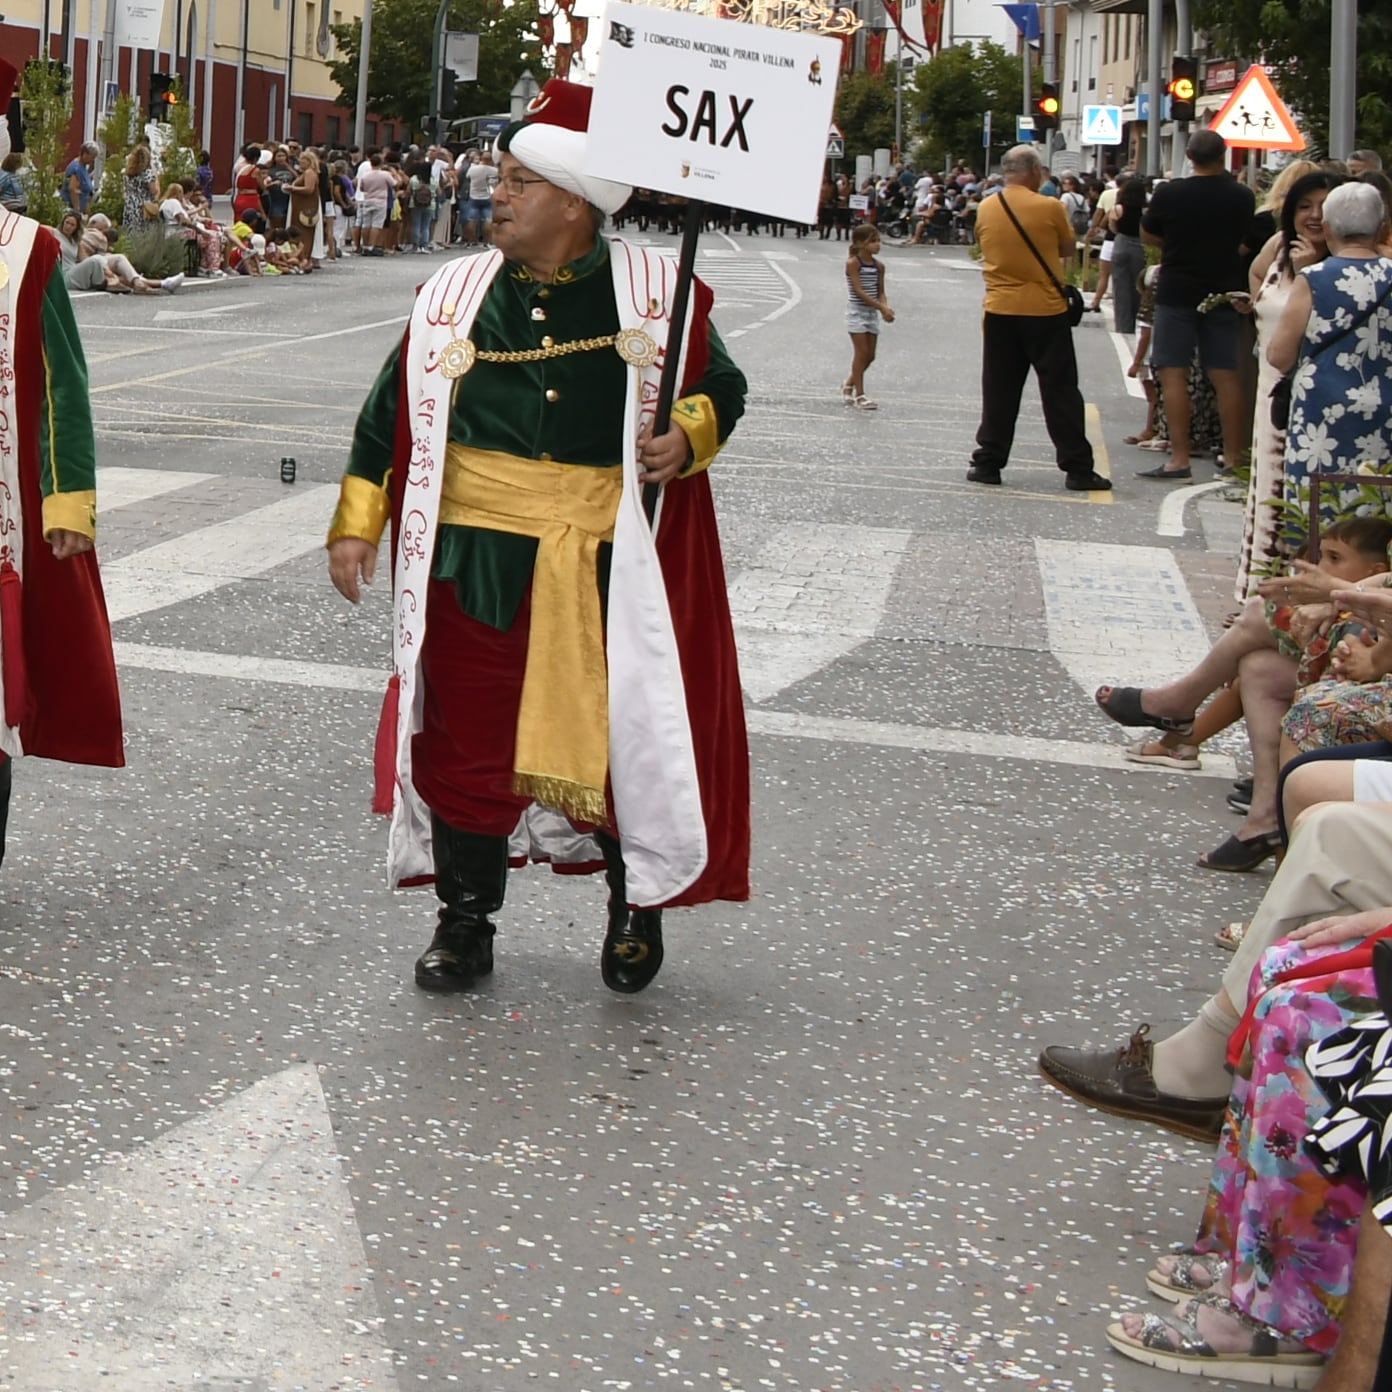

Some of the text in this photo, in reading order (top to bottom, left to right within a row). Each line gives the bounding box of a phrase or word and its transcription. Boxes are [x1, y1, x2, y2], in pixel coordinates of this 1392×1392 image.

[649, 33, 691, 50] CONGRESO
[692, 41, 731, 58] NACIONAL
[733, 47, 760, 63] PIRATA
[762, 54, 795, 69] VILLENA
[709, 58, 727, 70] 2025
[661, 84, 754, 152] SAX
